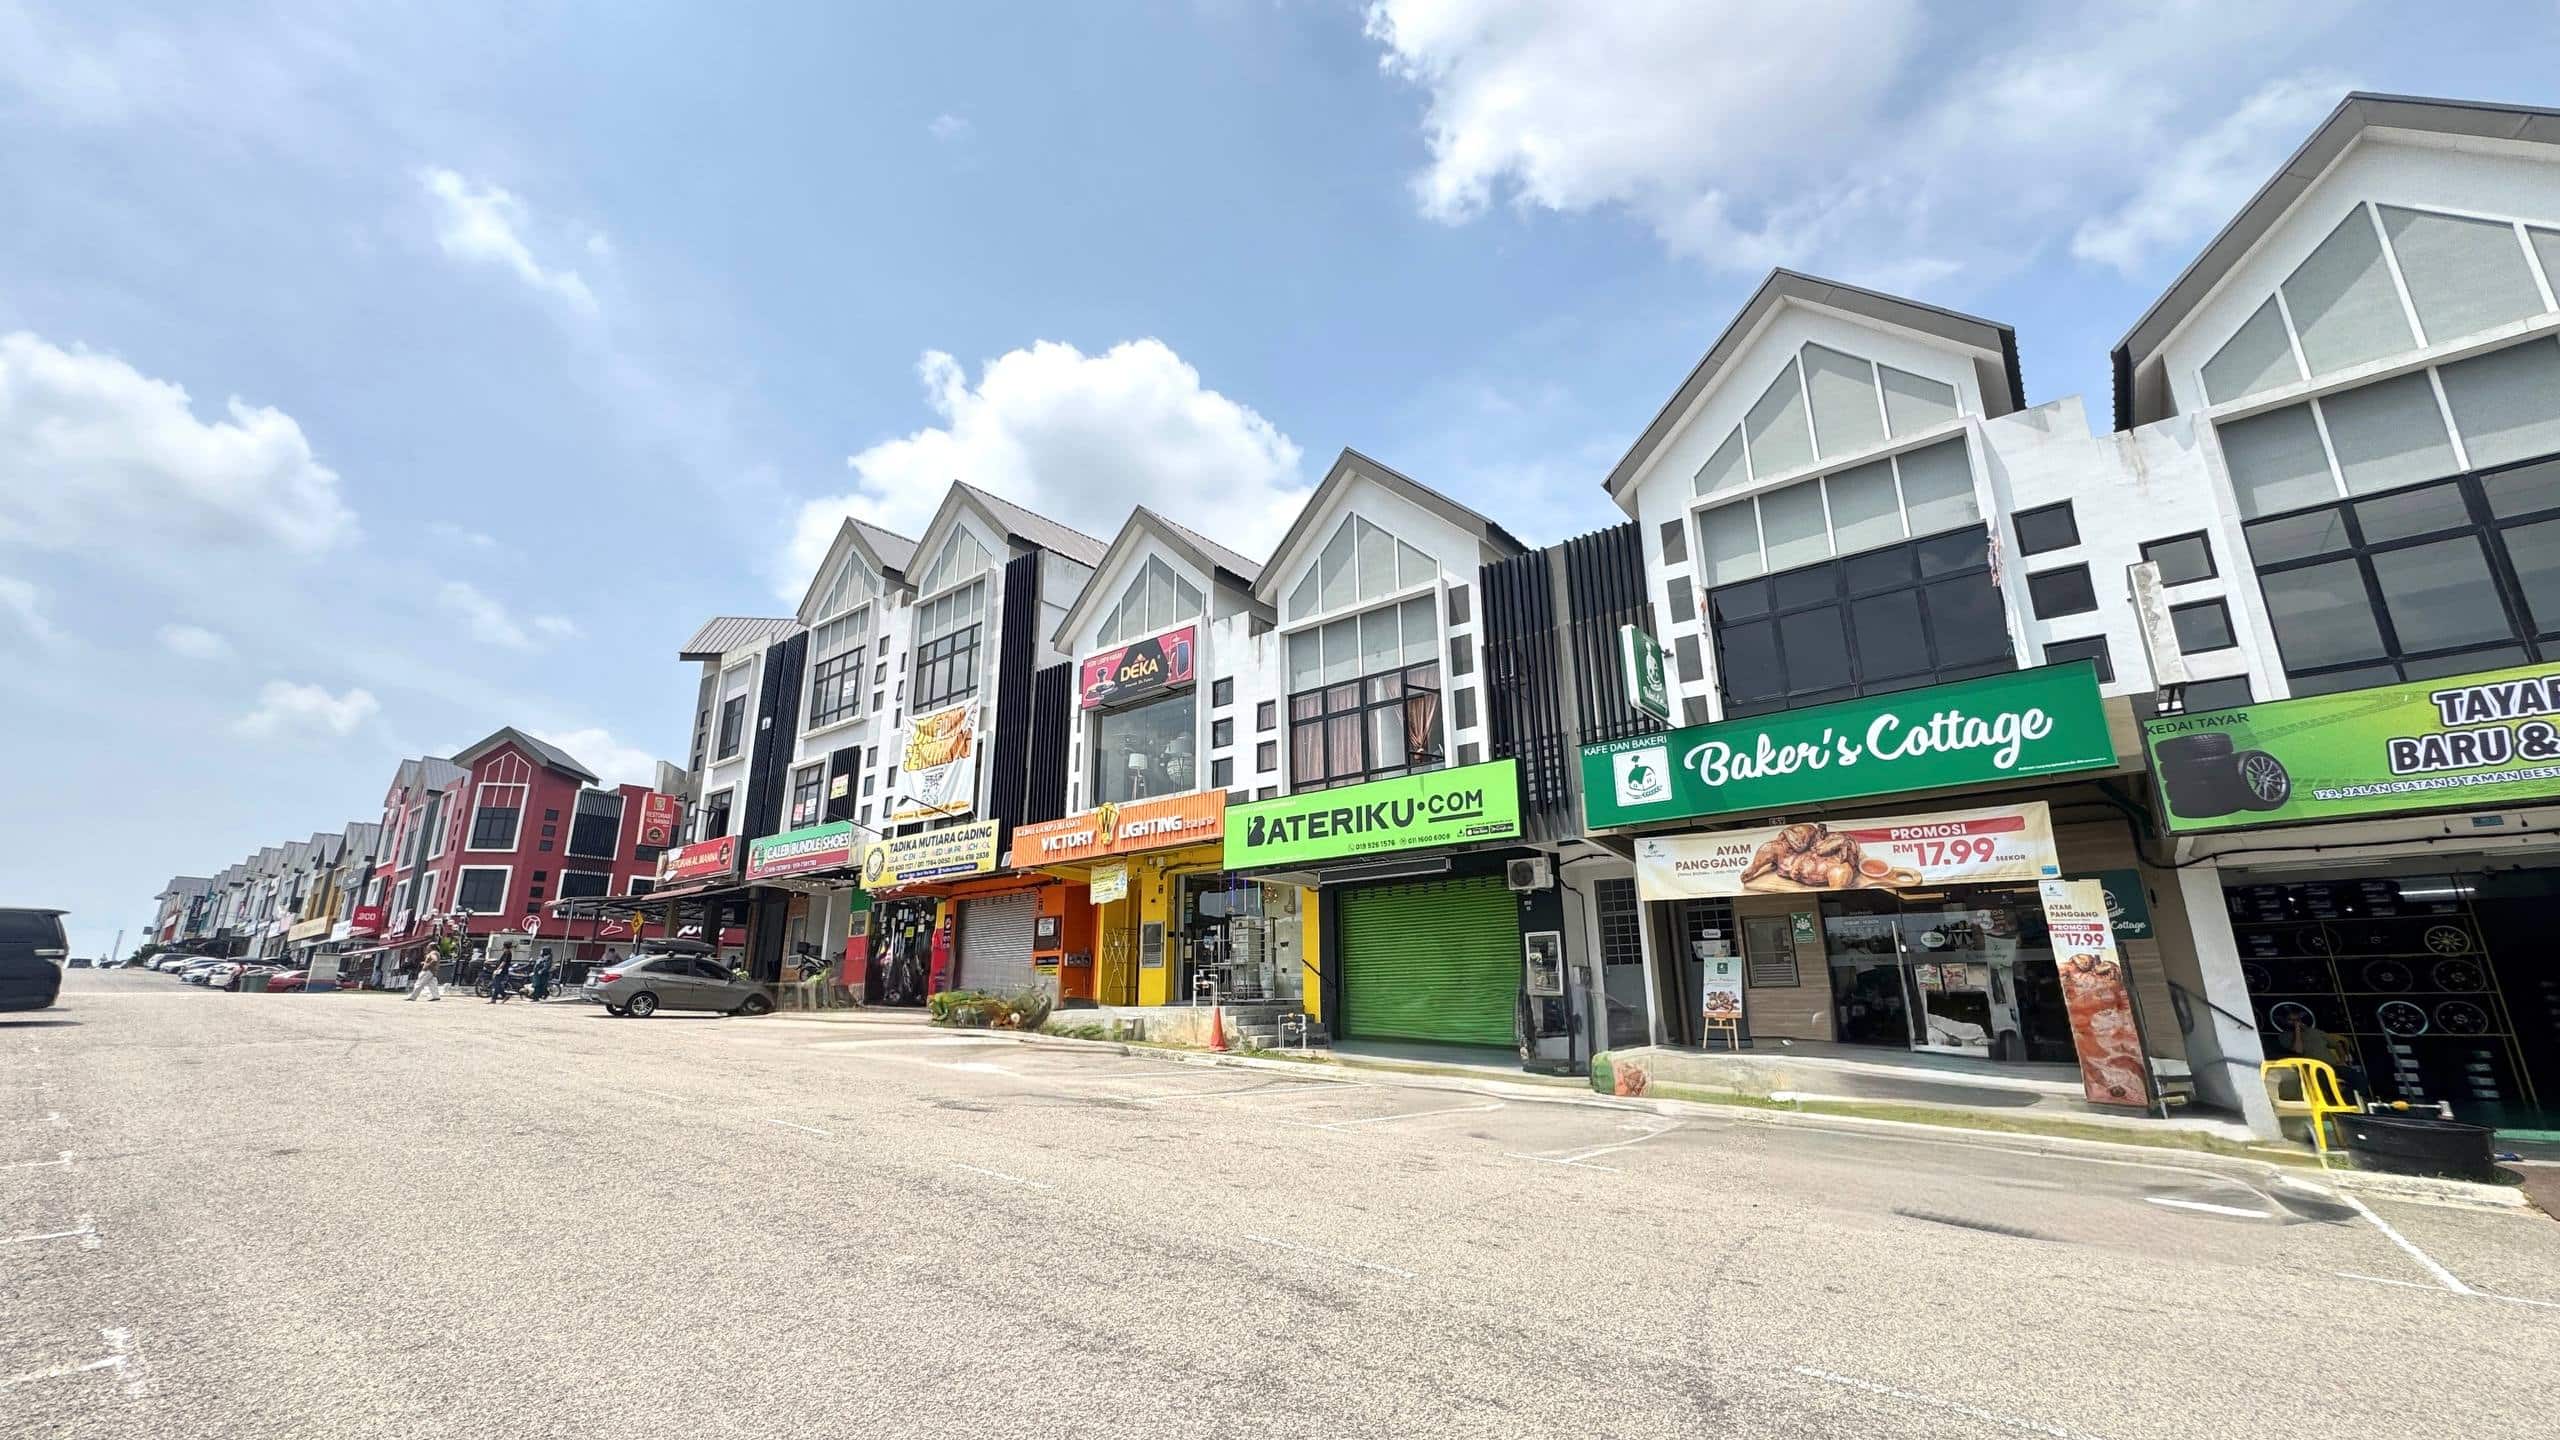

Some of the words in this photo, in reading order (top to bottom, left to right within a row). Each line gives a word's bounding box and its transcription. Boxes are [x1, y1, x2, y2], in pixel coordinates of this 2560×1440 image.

[1120, 658, 1159, 682] DEKA
[2145, 721, 2193, 735] KEDAI
[2196, 713, 2249, 728] TAYAR
[1584, 745, 1608, 756] KAFE
[1610, 742, 1630, 752] DAN
[1631, 735, 1667, 749] BAKERI
[1684, 728, 1863, 786] Baker's
[1866, 708, 2053, 769] Cottage
[2390, 727, 2510, 773] BARU
[2343, 784, 2391, 797] JALAN
[2391, 779, 2447, 793] SIATAN
[2460, 772, 2518, 787] TAMAN
[822, 832, 849, 850] SHOES
[889, 840, 917, 853] TADIKA
[919, 832, 956, 848] MUTIARA
[958, 826, 992, 841] GADING
[1041, 831, 1094, 851] VICTORY
[1119, 816, 1183, 839] LIGHTING
[1890, 823, 1967, 840] PROMOSI
[1716, 844, 1751, 856] AYAM
[1675, 856, 1749, 871] PANGGANG
[2111, 920, 2146, 933] Cottage
